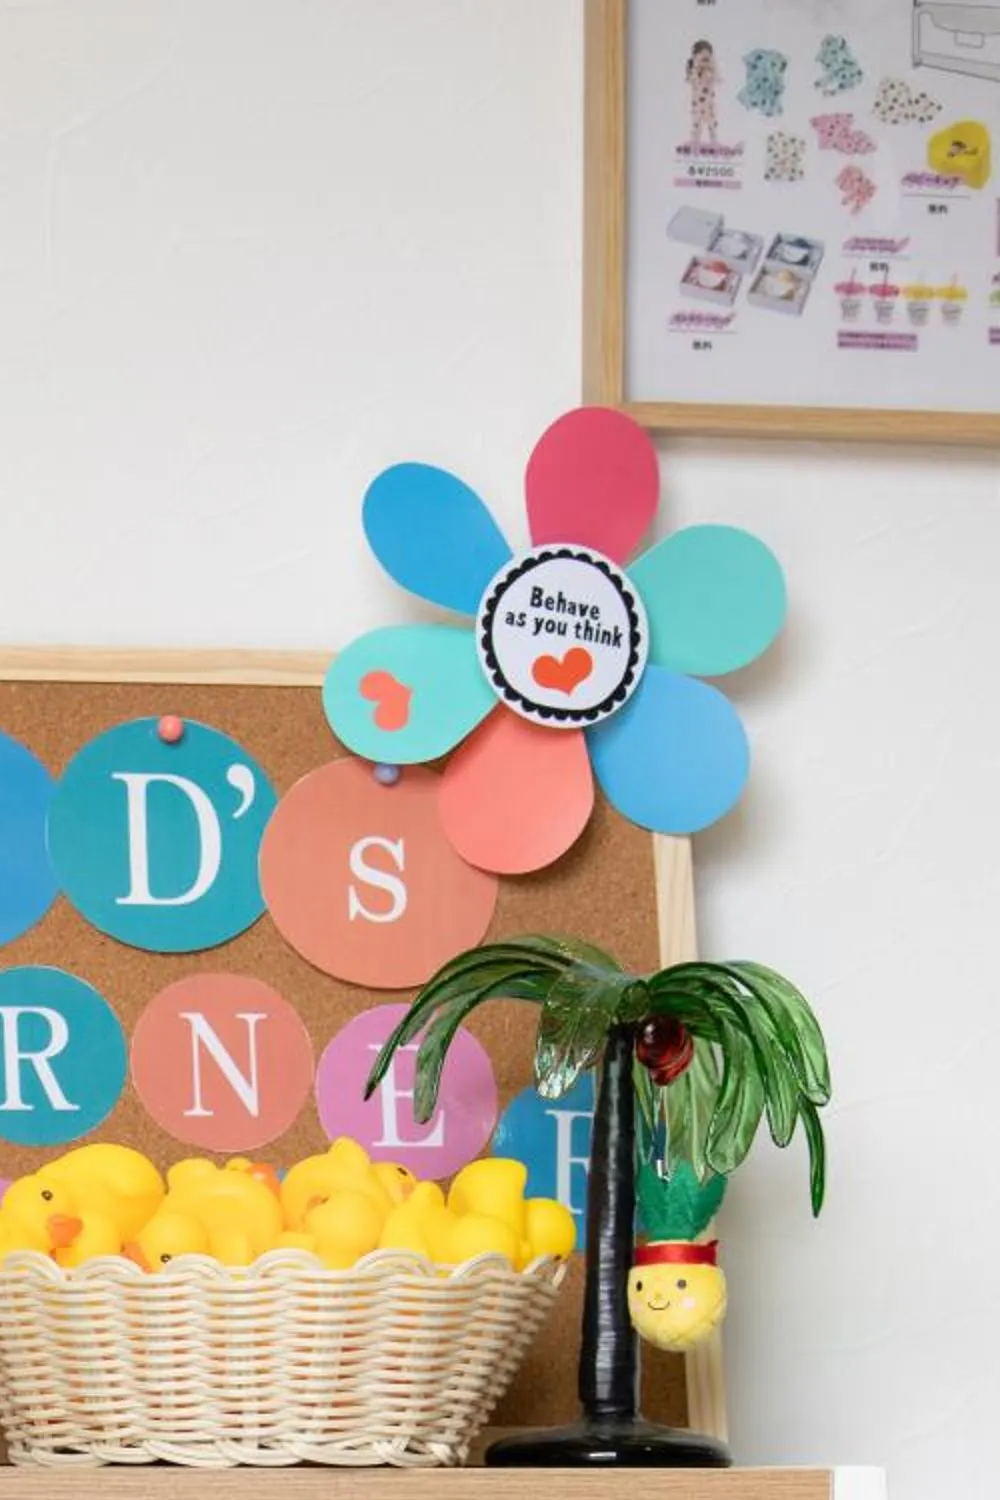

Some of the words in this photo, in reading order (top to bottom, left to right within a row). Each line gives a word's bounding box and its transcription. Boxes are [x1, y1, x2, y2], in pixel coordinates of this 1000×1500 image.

[529, 585, 600, 621] Behave
[505, 611, 526, 627] as
[532, 617, 568, 636] you
[574, 620, 623, 648] think
